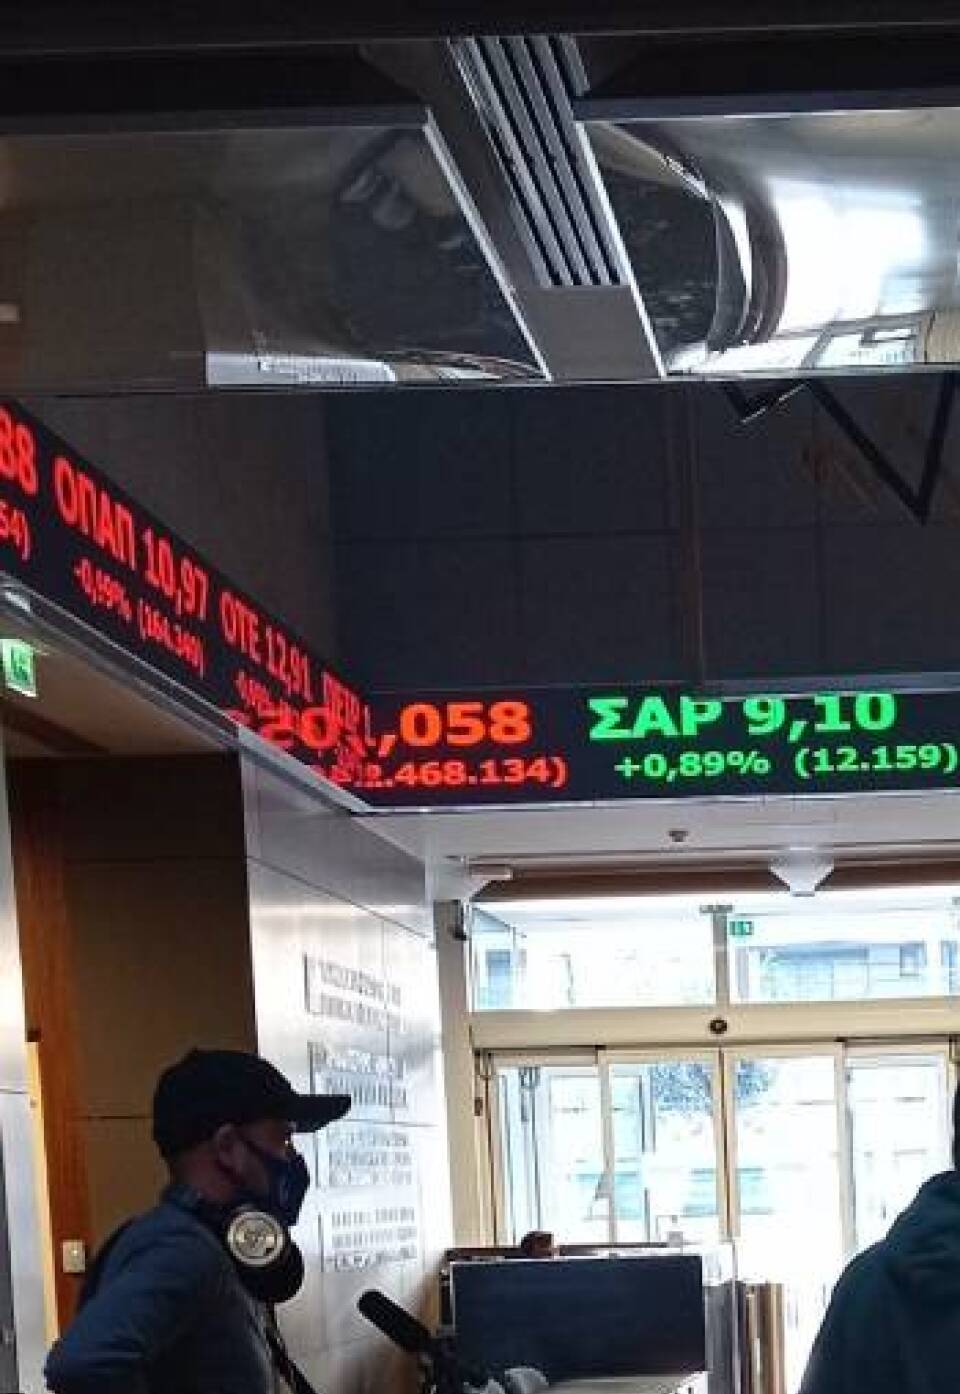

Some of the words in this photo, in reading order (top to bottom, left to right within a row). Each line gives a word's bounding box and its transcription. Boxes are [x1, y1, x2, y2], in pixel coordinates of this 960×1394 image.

[53, 456, 136, 571] ΟΠΑΠ
[143, 527, 209, 621] 10,97
[587, 695, 722, 741] ΣΑΡ
[743, 693, 897, 741] 9,10
[613, 750, 769, 782] +0,89%
[793, 743, 958, 778] (12.159)
